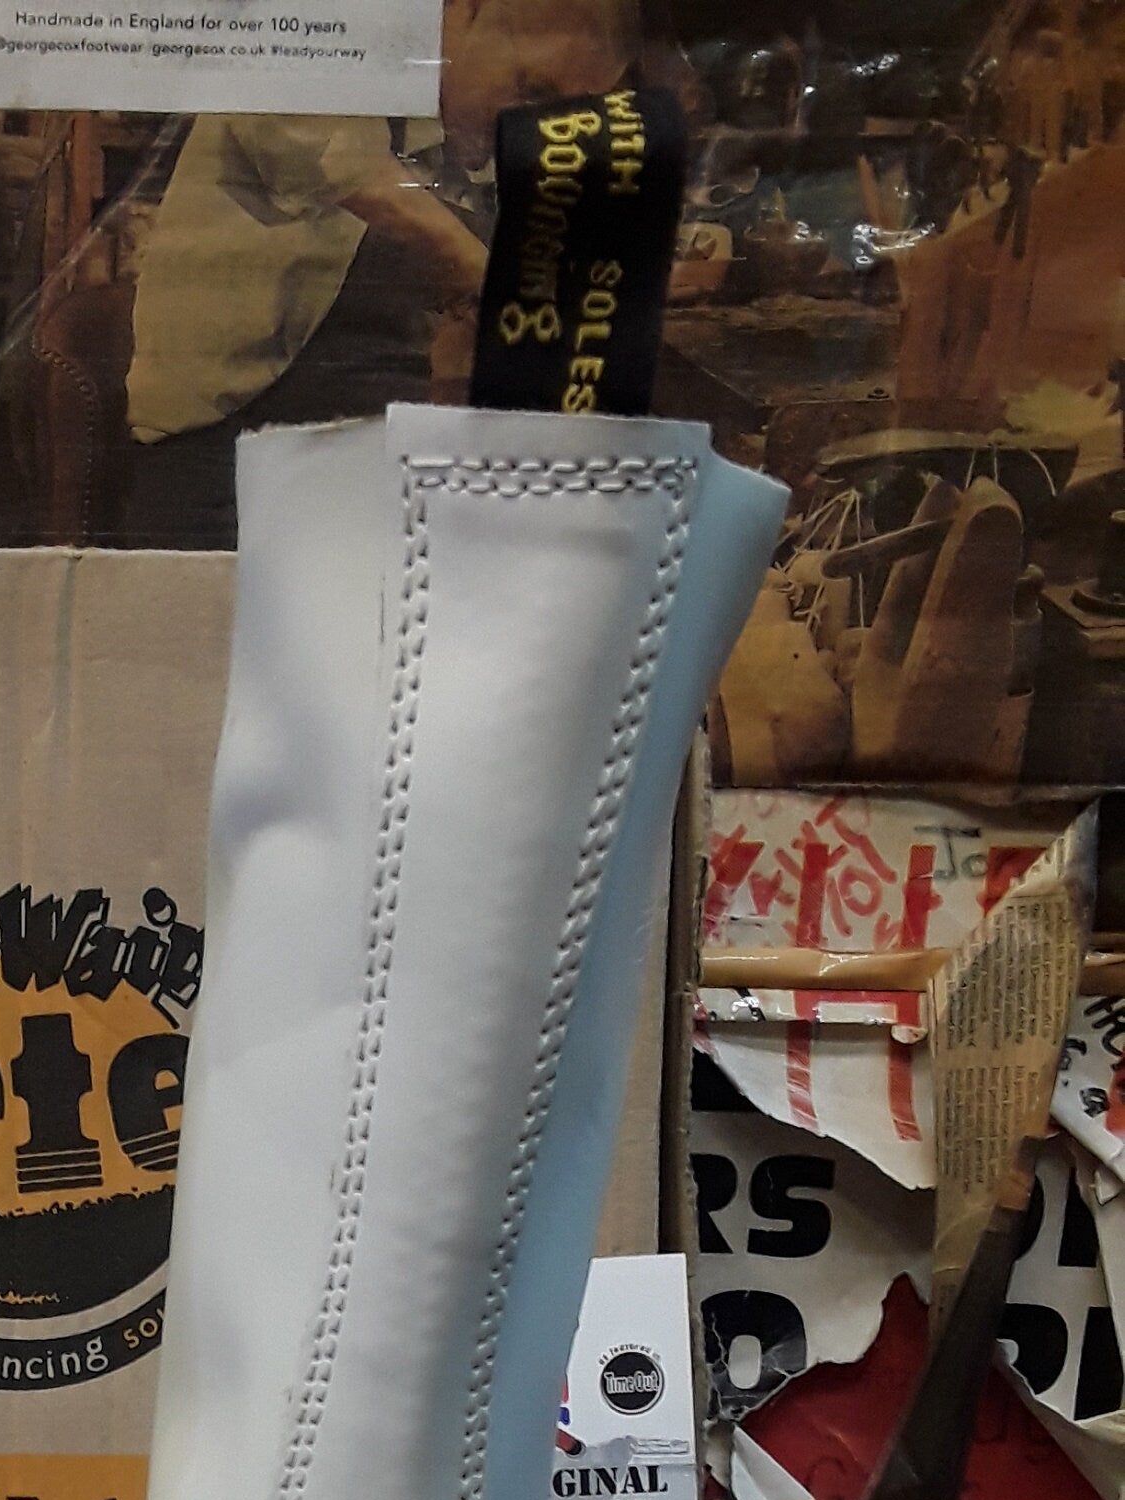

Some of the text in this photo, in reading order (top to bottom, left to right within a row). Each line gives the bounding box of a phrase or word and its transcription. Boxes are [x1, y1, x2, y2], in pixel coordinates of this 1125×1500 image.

[15, 11, 347, 36] Handmade in England for over 100 years
[552, 1465, 669, 1498] GINAL
